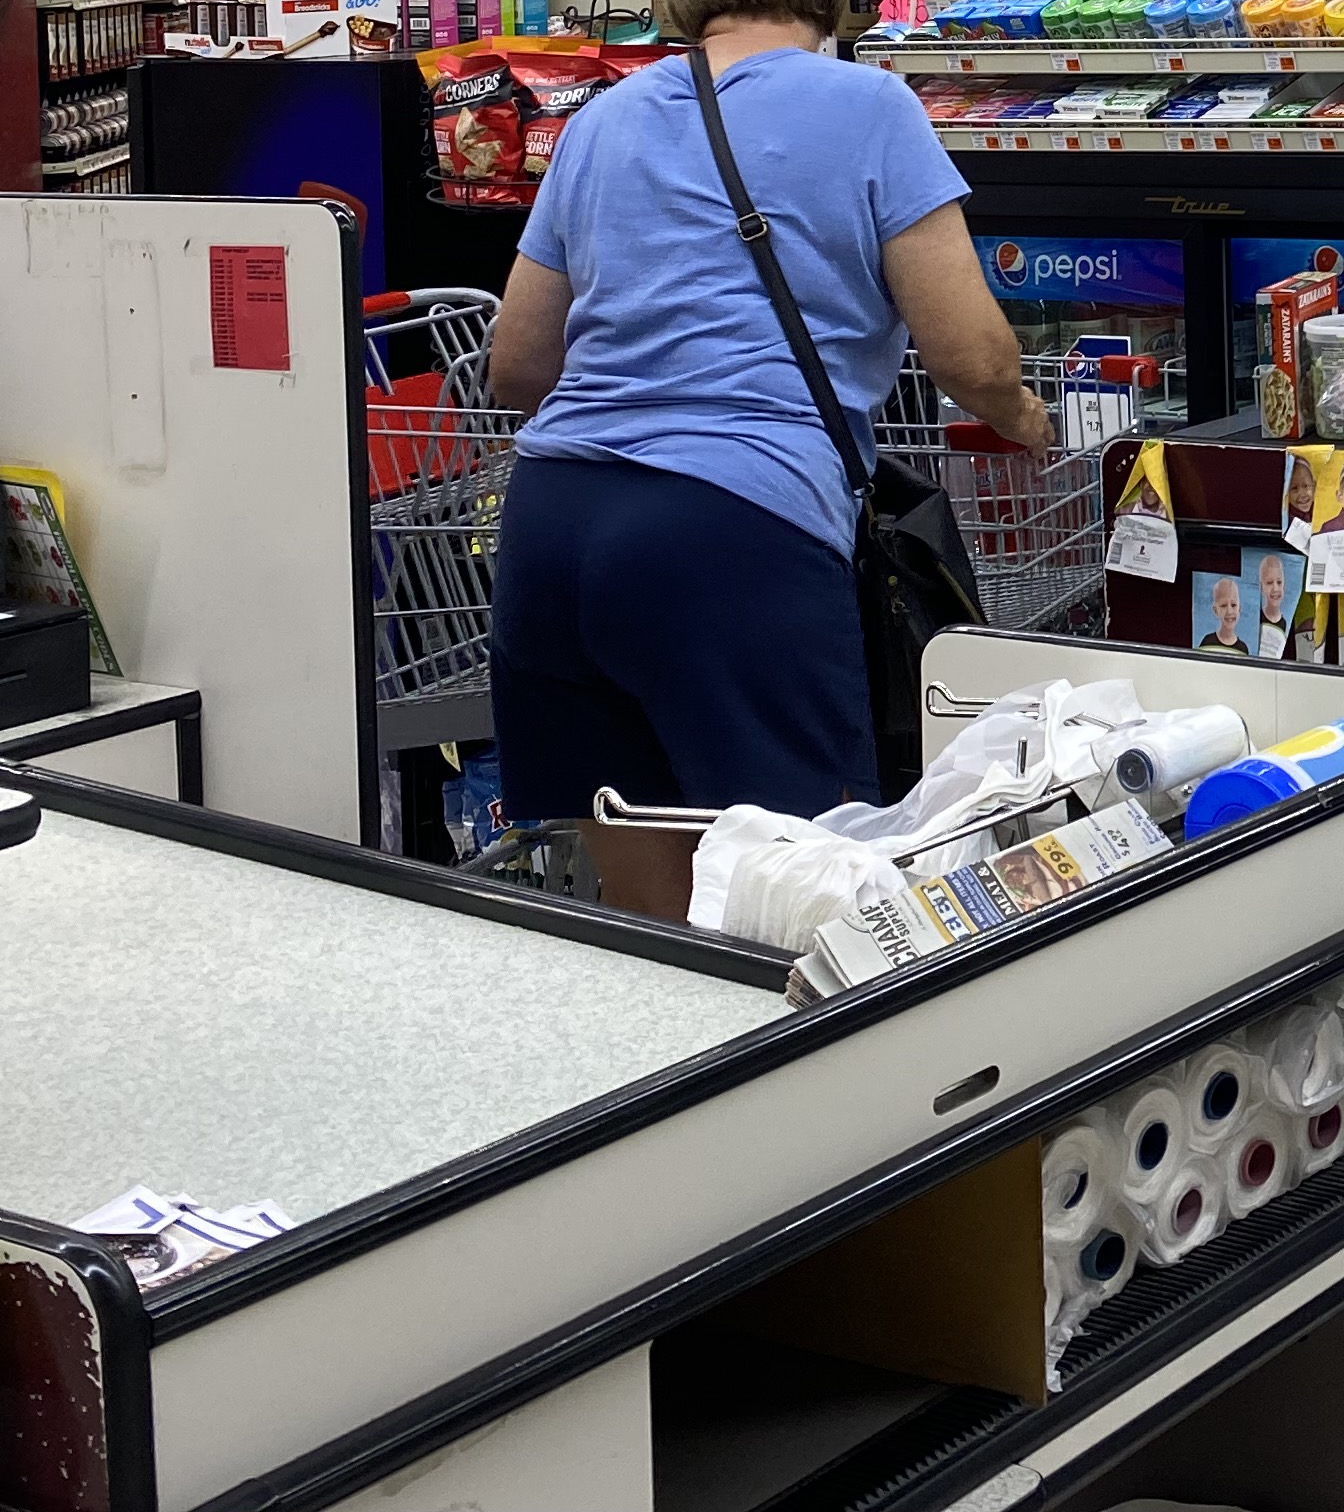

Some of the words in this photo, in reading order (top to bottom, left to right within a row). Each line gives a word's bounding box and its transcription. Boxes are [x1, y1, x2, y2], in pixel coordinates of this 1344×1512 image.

[445, 73, 500, 103] CORNERS
[1034, 250, 1118, 286] pepsi
[1297, 283, 1332, 310] ZATARAIN'S
[1281, 308, 1292, 364] ZATARAIN'S
[977, 866, 990, 878] &
[987, 879, 1017, 918] MEAT
